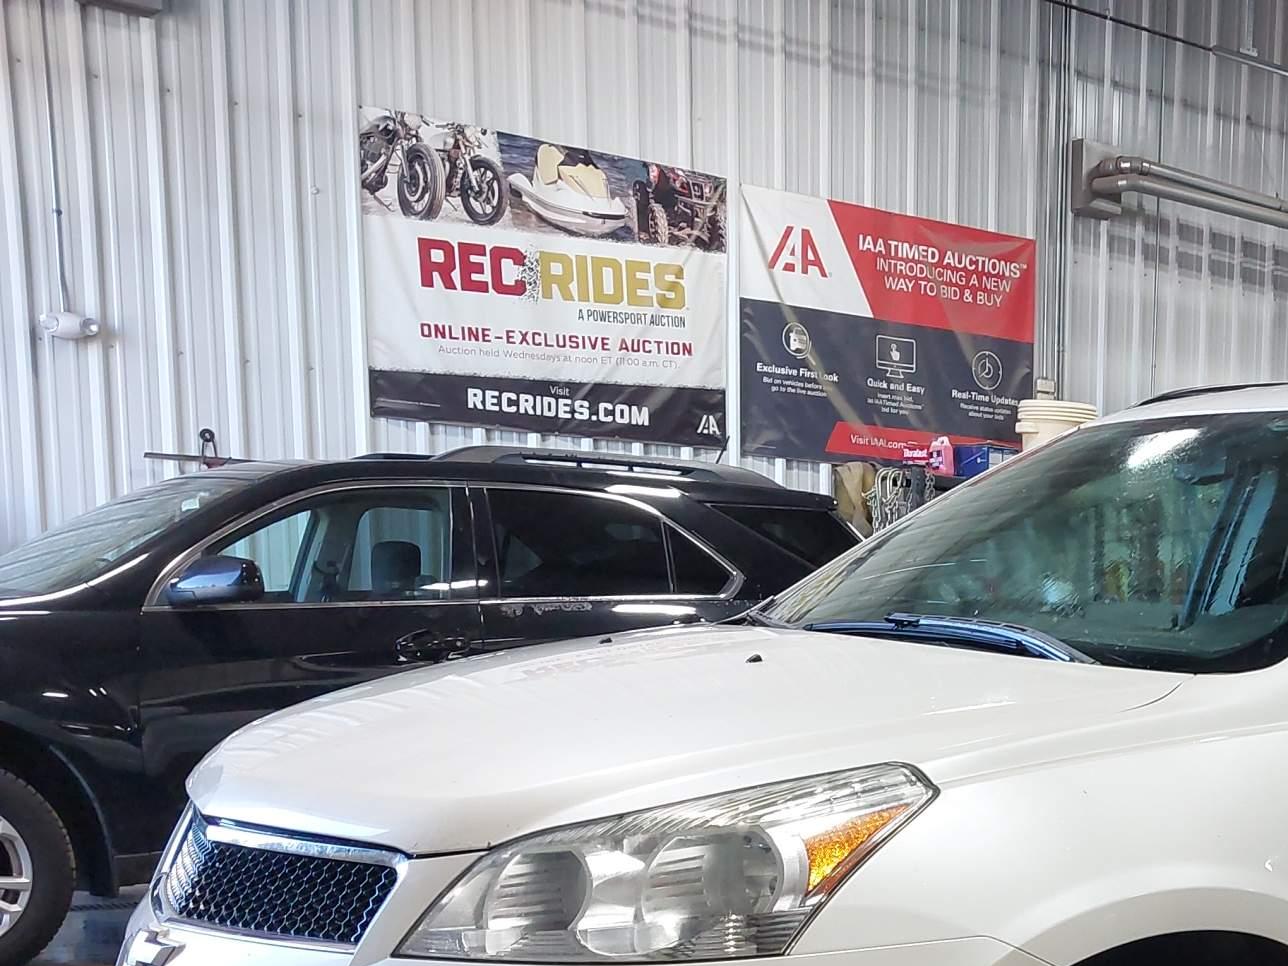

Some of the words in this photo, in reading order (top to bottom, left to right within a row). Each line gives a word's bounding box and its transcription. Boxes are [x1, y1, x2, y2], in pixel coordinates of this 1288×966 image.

[859, 234, 886, 254] IAA
[888, 240, 939, 264] TIMED
[417, 236, 528, 297] REC
[538, 250, 687, 310] RIDES
[876, 257, 966, 286] INTRODUCING
[969, 275, 979, 288] A
[982, 276, 1012, 293] NEW
[884, 276, 915, 293] WAY
[918, 280, 937, 297] TO
[940, 285, 960, 301] BID
[963, 289, 974, 304] &
[976, 291, 1004, 308] BUY
[577, 308, 585, 321] A
[587, 308, 648, 325] POWERSPORT
[649, 313, 686, 329] AUCTION
[420, 322, 611, 352] ONLINE-EXCLUSIVE
[618, 337, 693, 357] AUCTION
[438, 345, 476, 357] Auction
[479, 347, 500, 359] held
[502, 349, 561, 363] Wednesdays
[575, 355, 598, 365] noon
[600, 356, 612, 366] ET
[756, 362, 798, 377] Exclusive
[799, 367, 818, 379] First
[549, 384, 570, 397] Visit
[867, 377, 888, 390] Quick
[890, 380, 904, 392] and
[906, 383, 926, 395] Easy
[467, 387, 649, 427] RECRIDES.COM
[951, 389, 990, 403] Real-Time
[991, 394, 1019, 406] Updates
[850, 434, 869, 446] Visit
